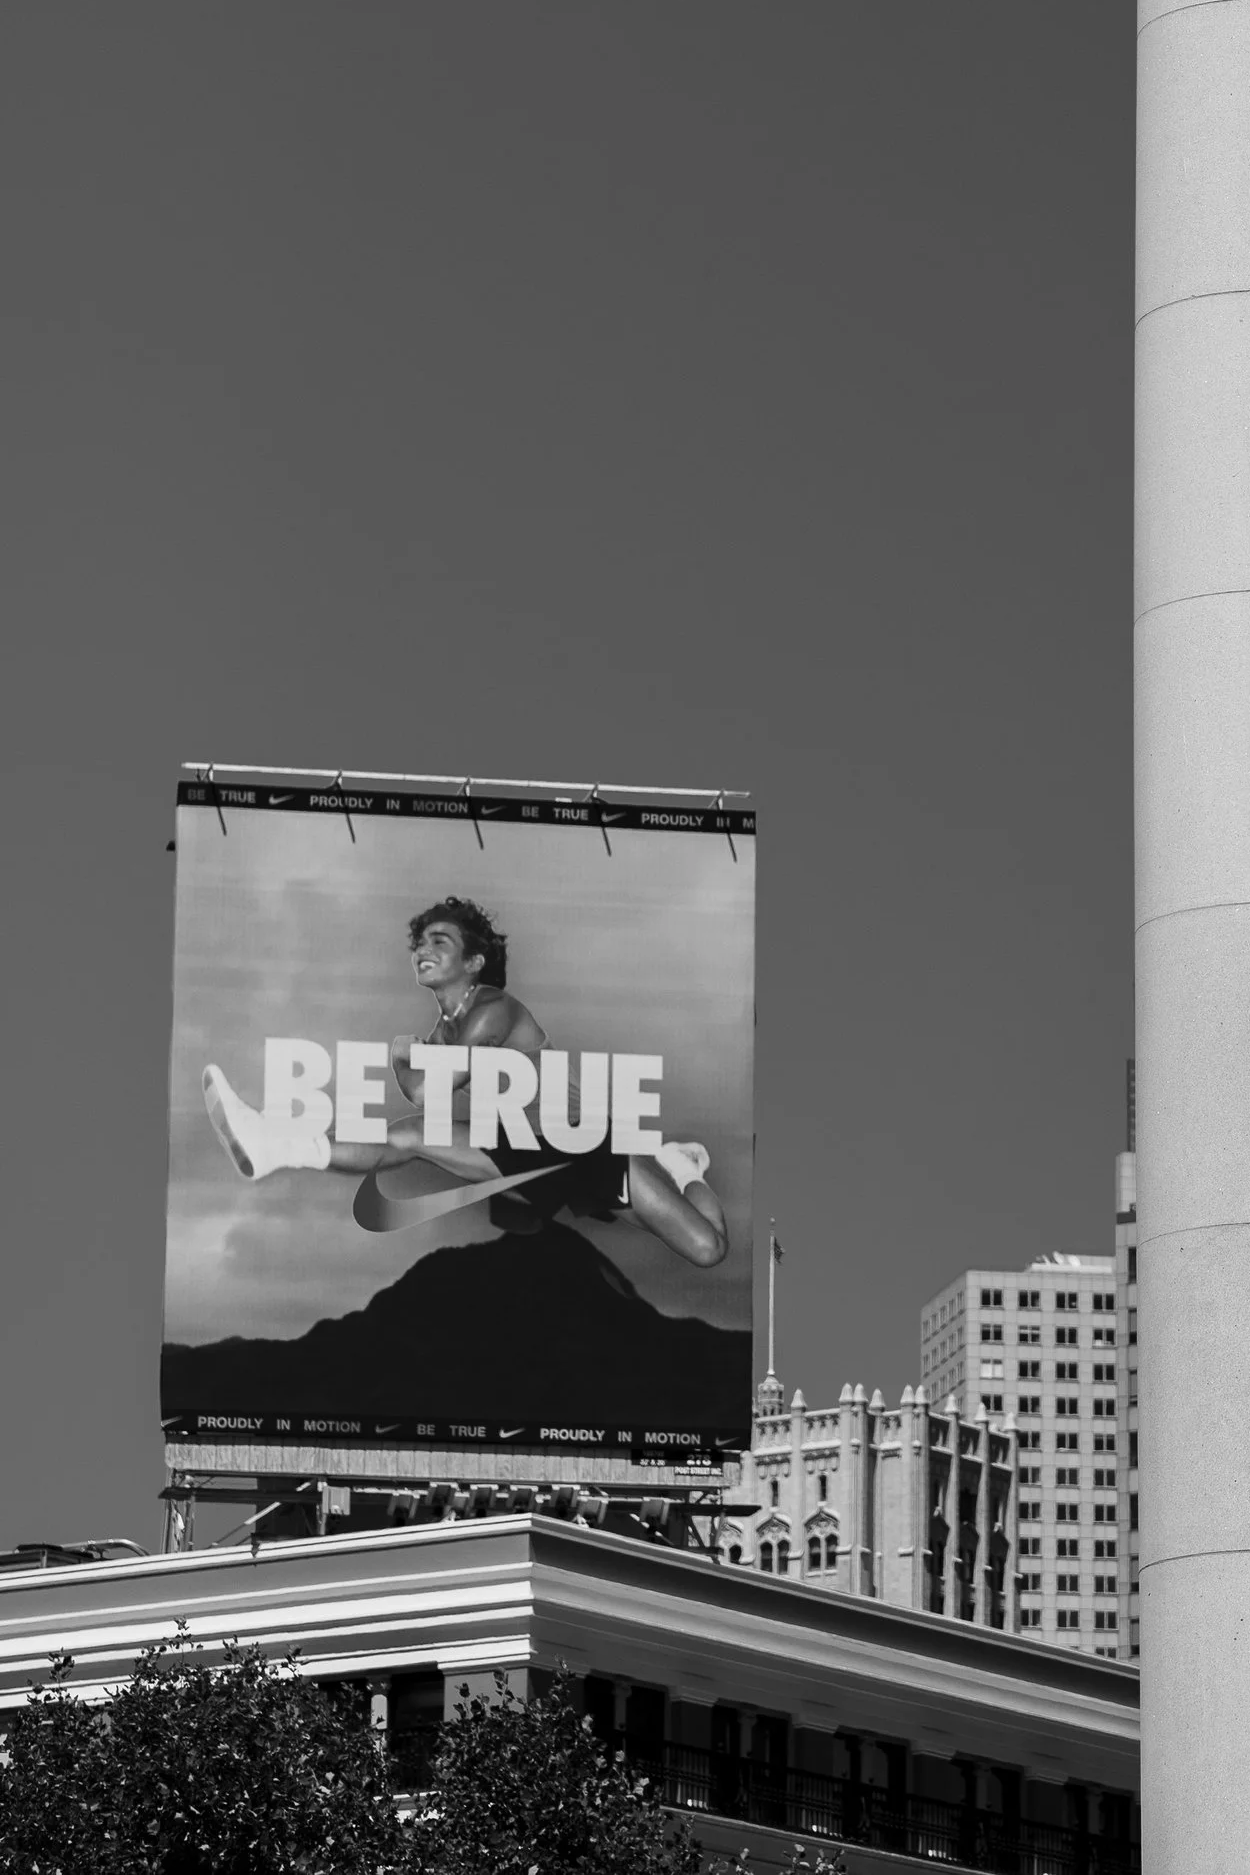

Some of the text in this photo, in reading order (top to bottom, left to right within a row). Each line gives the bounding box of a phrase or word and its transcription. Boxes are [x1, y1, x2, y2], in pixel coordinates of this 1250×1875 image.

[187, 788, 206, 802] BE
[219, 789, 256, 804] TRUE
[309, 794, 373, 810] PROUDLY
[386, 798, 400, 811] IN
[412, 799, 469, 814] MOTION
[521, 805, 539, 818] BE
[553, 807, 589, 821] TRUE
[641, 812, 704, 827] PROUDLY
[264, 1036, 663, 1156] BE TRUE
[197, 1416, 701, 1445] PROUDLY IN MOTION BE TRUE PROUDLY IN MOTION
